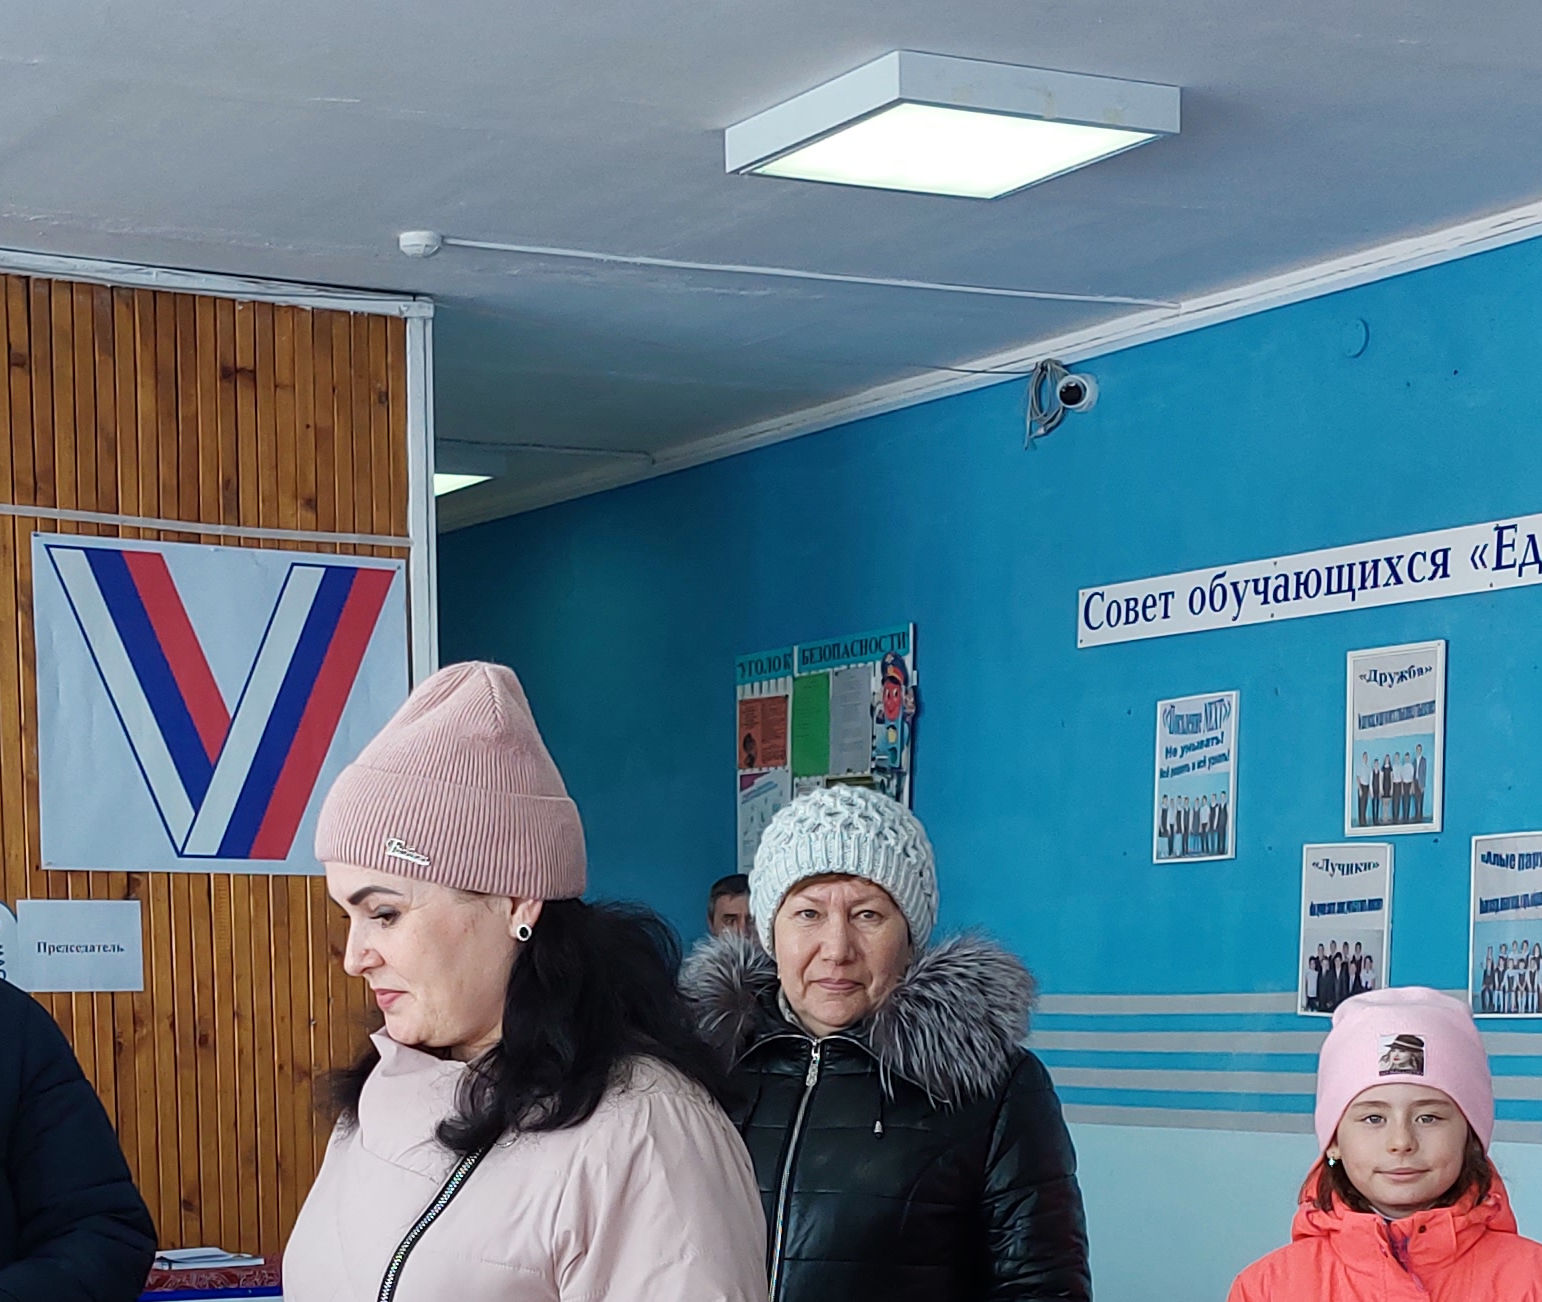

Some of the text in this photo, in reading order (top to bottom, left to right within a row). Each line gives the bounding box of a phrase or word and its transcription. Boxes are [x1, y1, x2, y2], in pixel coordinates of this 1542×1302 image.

[1082, 588, 1176, 632] Совет
[1187, 545, 1452, 625] обучающихся
[738, 631, 907, 679] УГОЛОК БЕЗОПАСНОСТИ
[1359, 664, 1433, 689] «Дружба»
[1312, 858, 1380, 878] «Лучики»
[36, 941, 125, 955] Председатель
